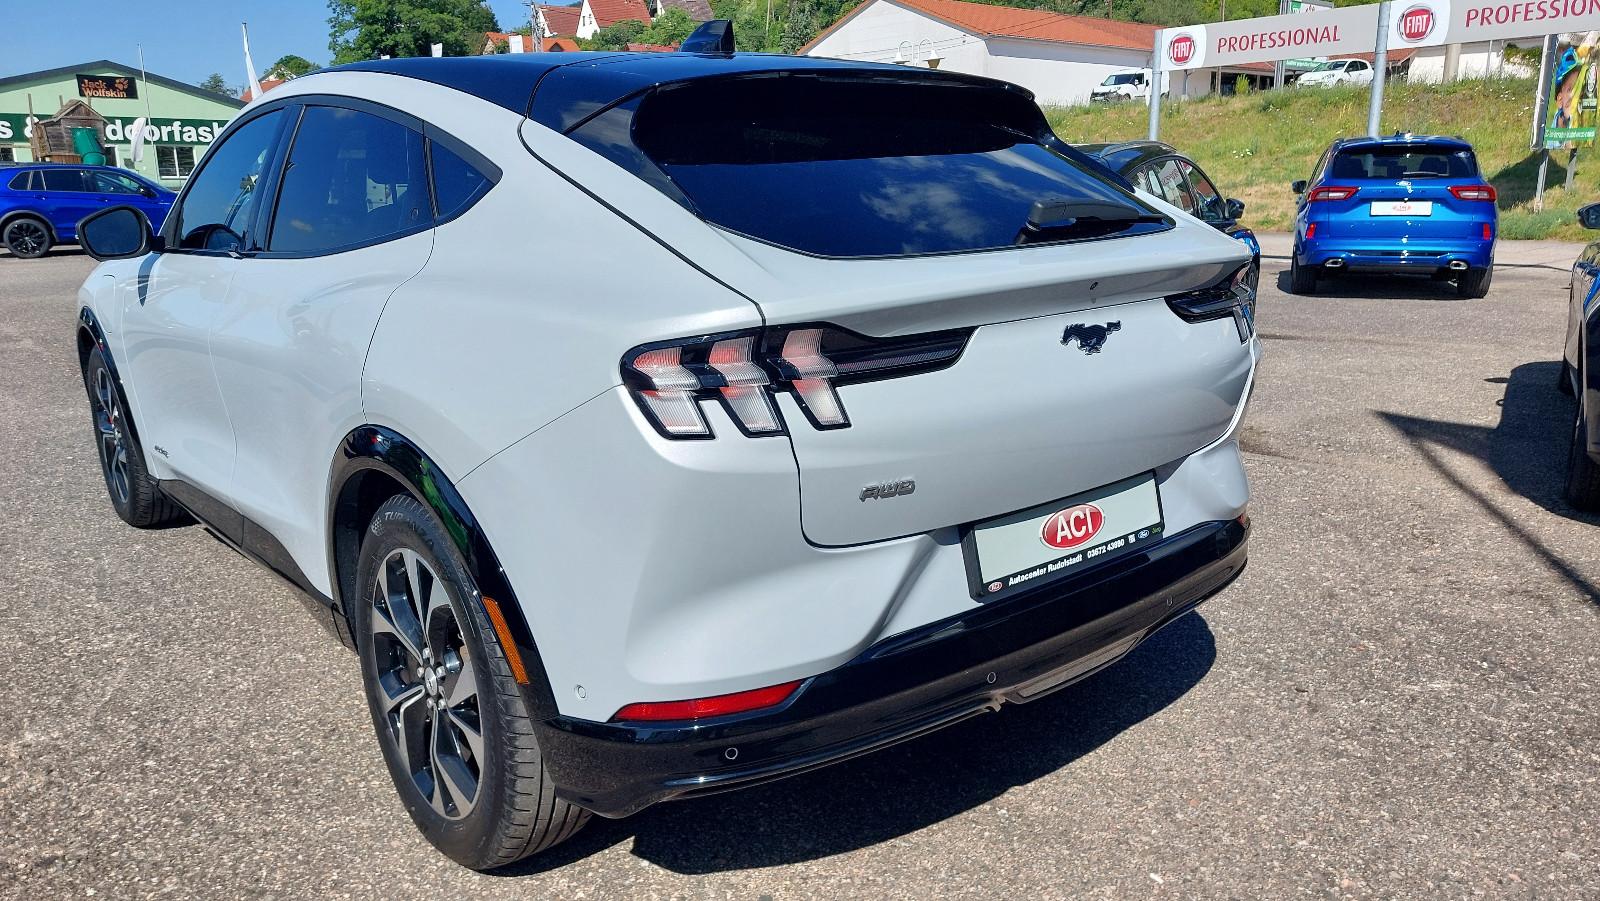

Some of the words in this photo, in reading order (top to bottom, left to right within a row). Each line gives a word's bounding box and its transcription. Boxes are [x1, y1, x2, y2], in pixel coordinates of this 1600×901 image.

[1406, 14, 1429, 34] FIAT
[1173, 41, 1191, 58] FIAT
[1217, 25, 1341, 53] PROFESSIONAL
[82, 78, 107, 89] Jack
[82, 87, 127, 98] Wolfskin
[859, 480, 916, 502] AWD
[1056, 508, 1094, 544] ACI
[1008, 567, 1047, 587] Autocenter
[1047, 553, 1083, 573] Rudolstadt
